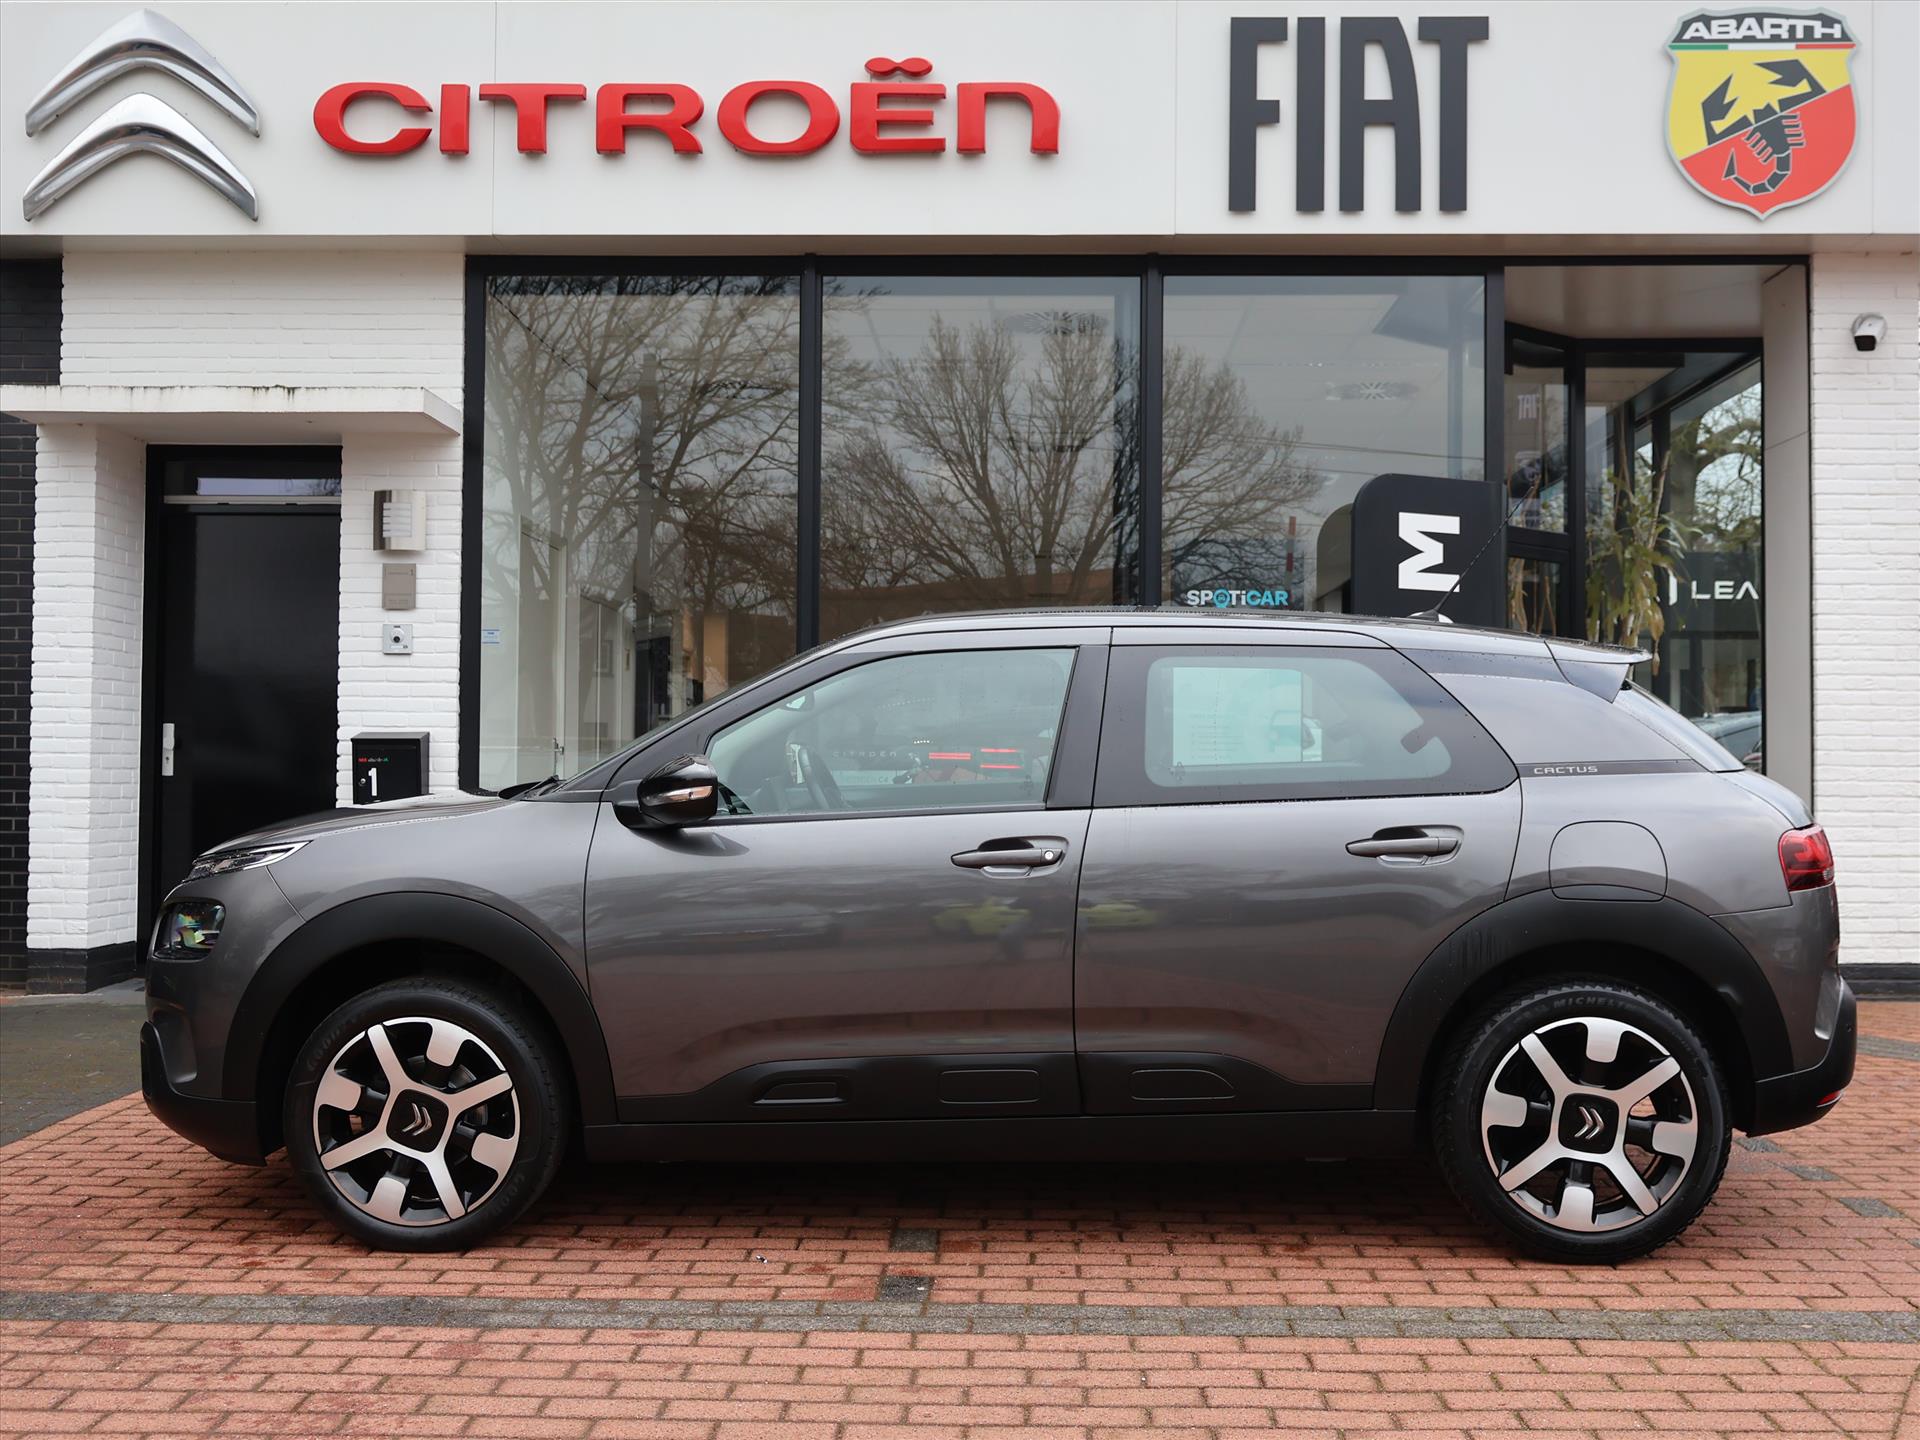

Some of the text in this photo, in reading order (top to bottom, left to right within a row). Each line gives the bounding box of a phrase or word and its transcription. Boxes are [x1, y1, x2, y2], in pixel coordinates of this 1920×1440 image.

[1682, 16, 1842, 40] ABARTH
[1228, 15, 1490, 212] FIAT
[368, 767, 377, 796] 1
[1533, 765, 1598, 775] CACTUS
